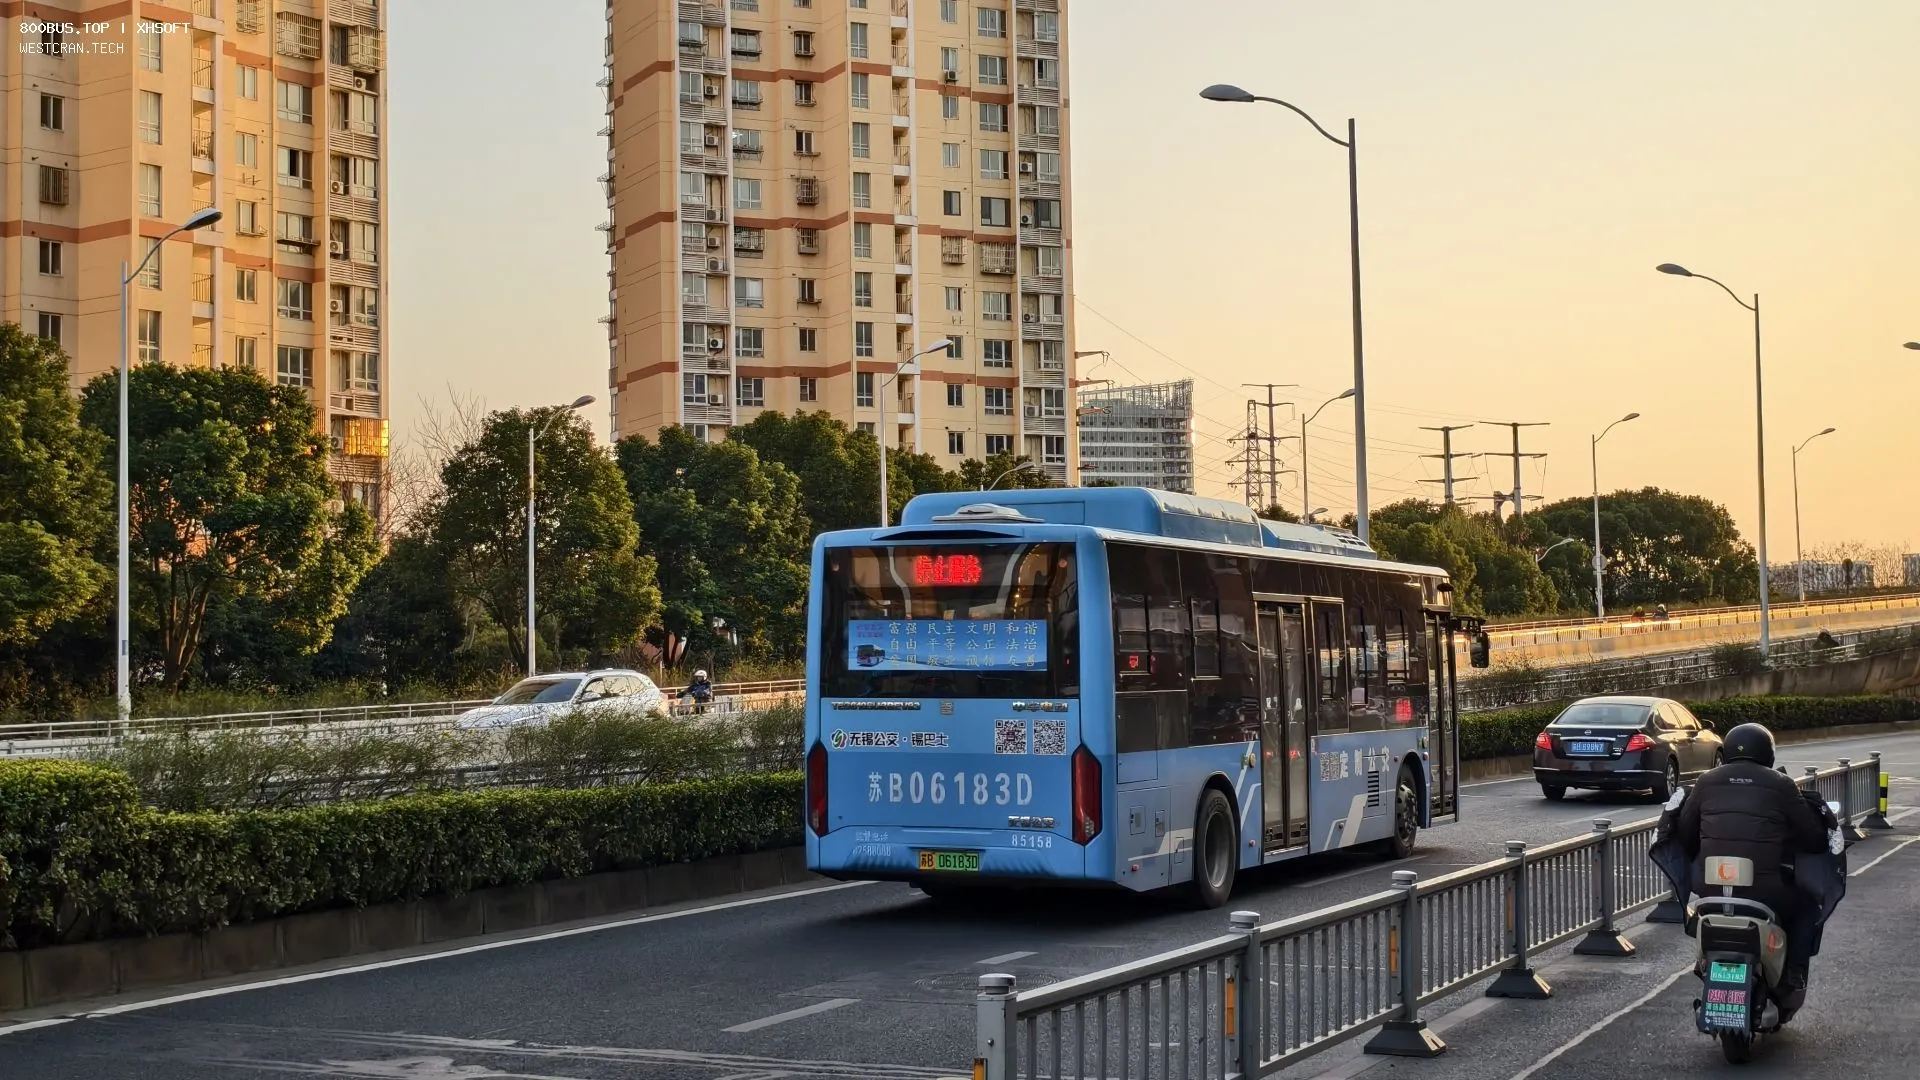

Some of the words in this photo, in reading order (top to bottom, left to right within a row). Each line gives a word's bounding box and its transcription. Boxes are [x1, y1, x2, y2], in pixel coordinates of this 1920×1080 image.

[889, 622, 917, 635] 富强
[927, 622, 957, 635] 民主
[966, 622, 996, 635] 文明
[1005, 622, 1038, 635] 和谐
[889, 638, 917, 651] 自由
[928, 638, 957, 651] 平等
[966, 638, 996, 651] 公正
[1006, 638, 1038, 651] 法治
[1011, 833, 1052, 848] 85158
